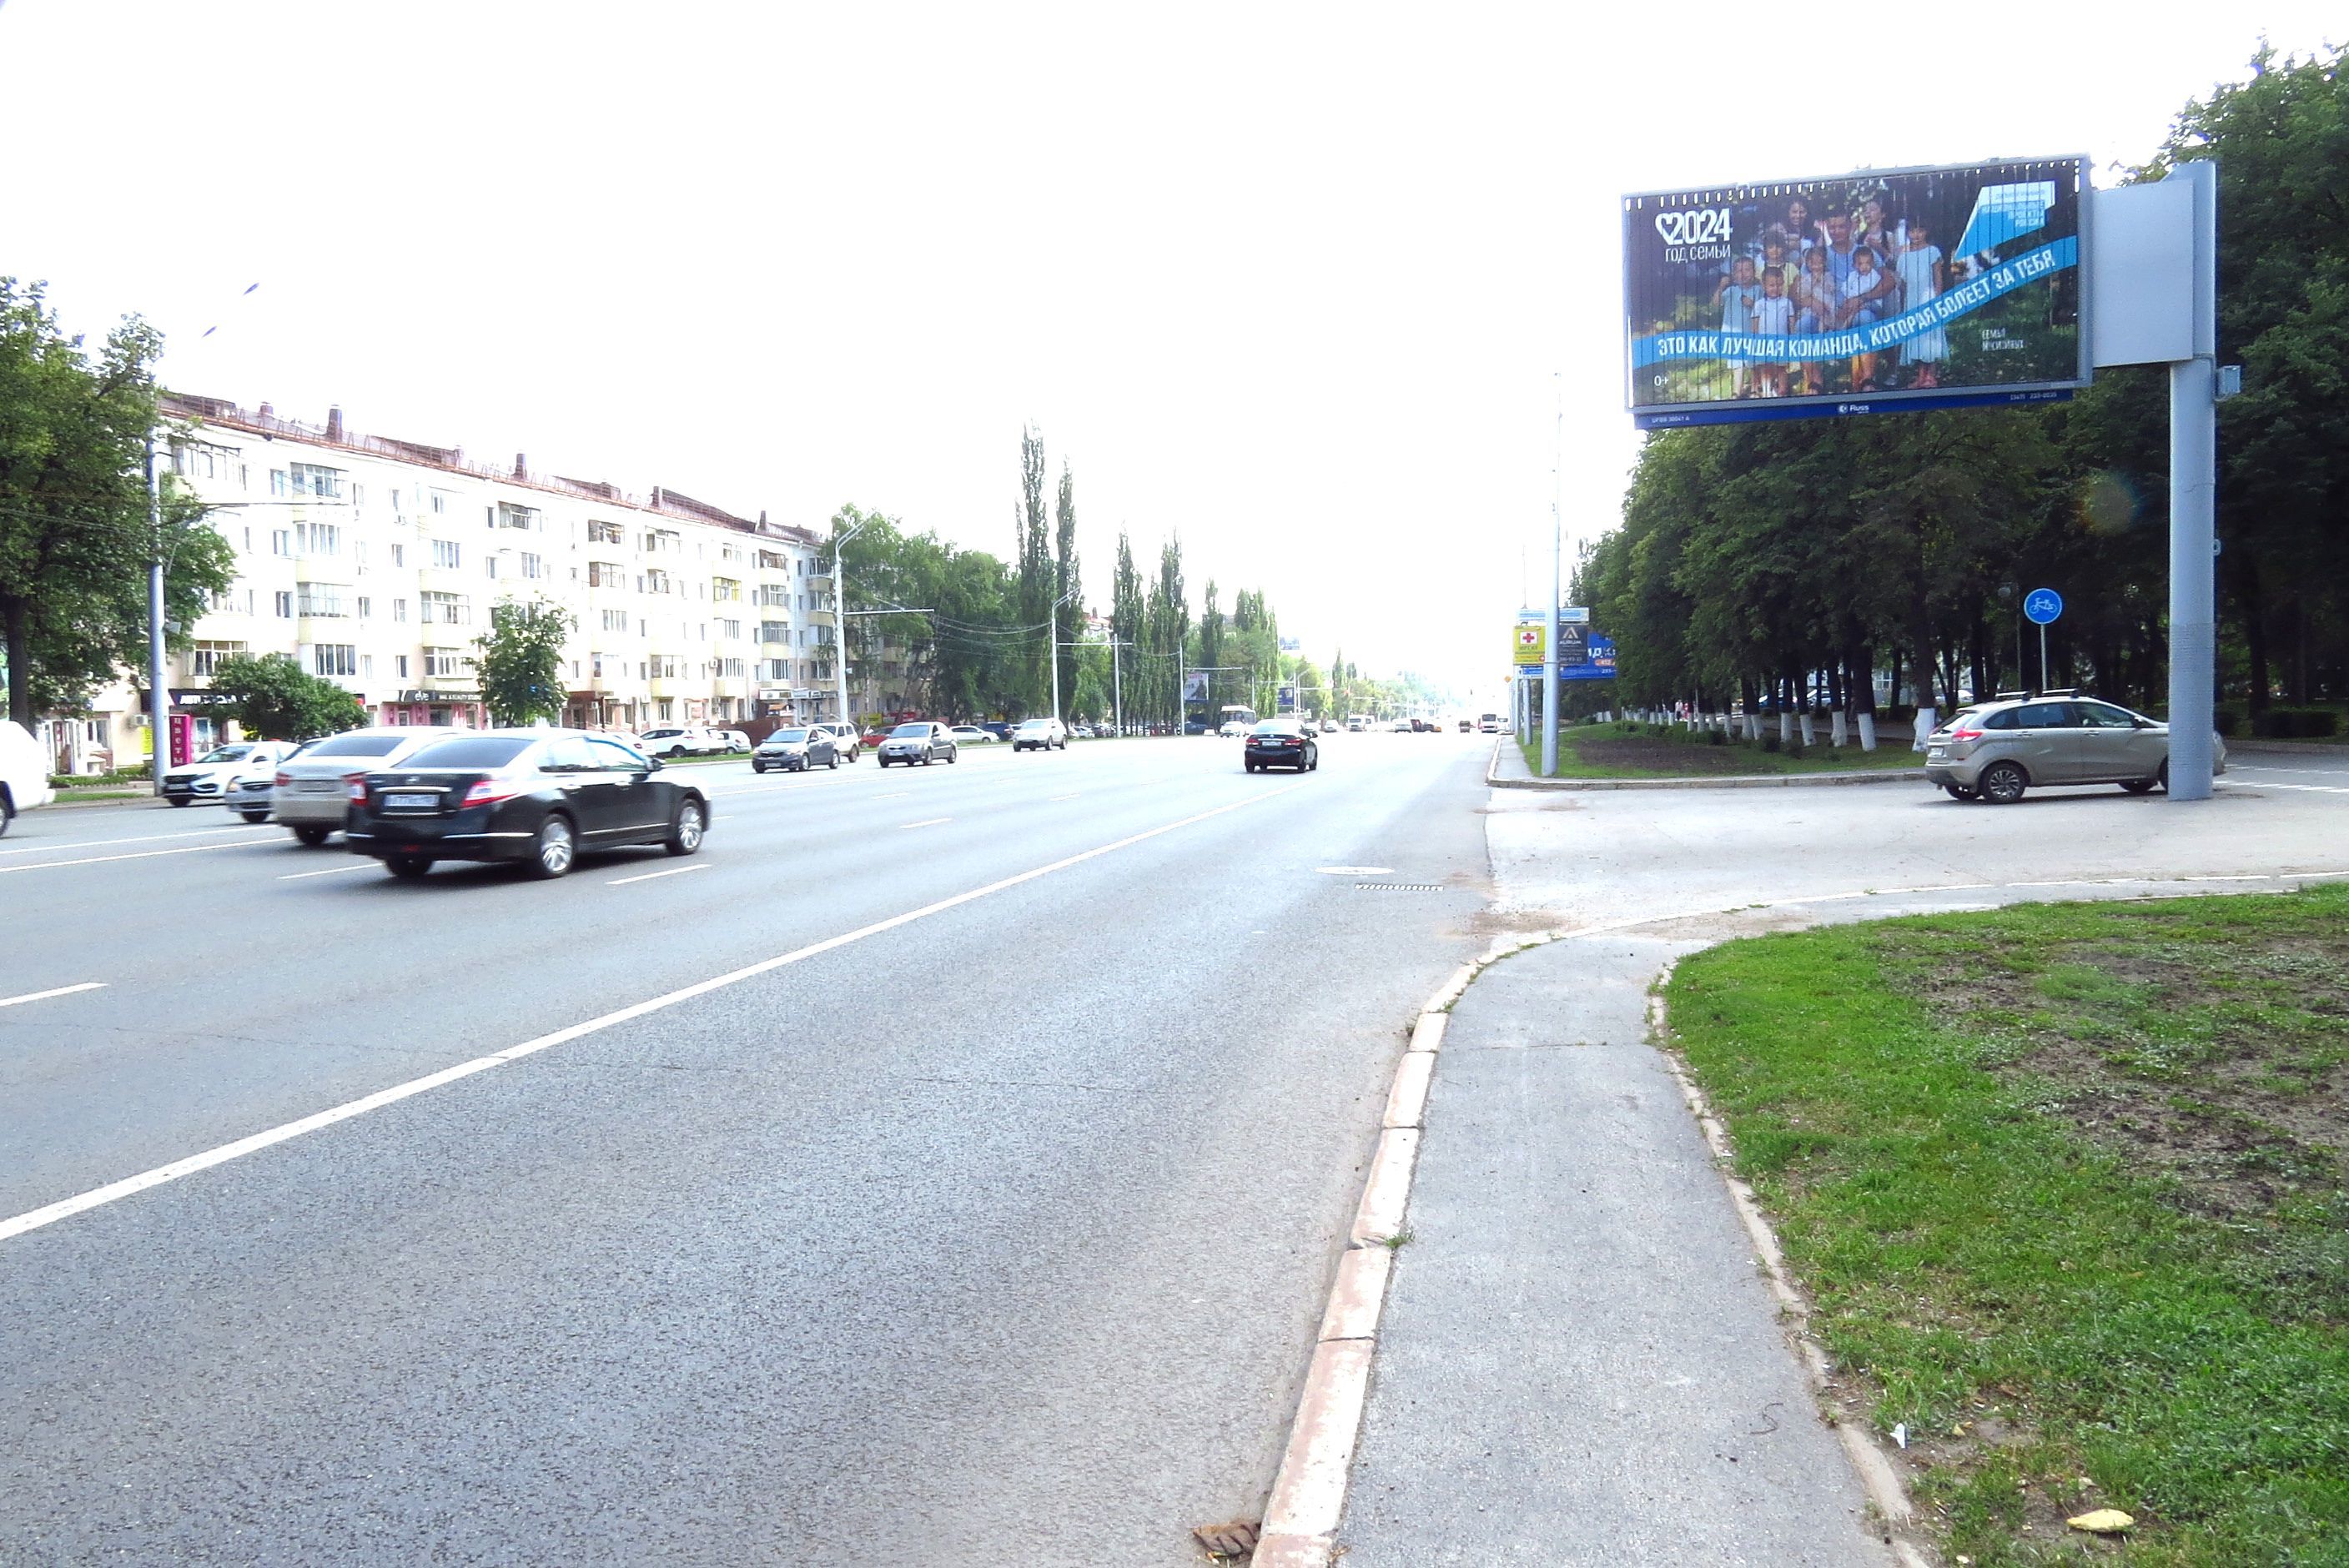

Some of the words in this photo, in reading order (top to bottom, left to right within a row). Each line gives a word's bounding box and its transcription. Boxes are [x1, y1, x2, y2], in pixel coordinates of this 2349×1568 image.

[1665, 208, 1733, 245] 2024
[1657, 336, 1685, 356] ЭТО
[1688, 335, 1718, 354] КАК
[1721, 336, 1785, 357] ЛУЧШАЯ
[1788, 333, 1868, 357] КОМАНДА,
[1869, 307, 1937, 346] КОТОРАЯ
[1934, 277, 1991, 319] БОЛЕЕТ
[1992, 271, 2015, 289] ЗА
[2015, 249, 2056, 279] ТЕБЯ
